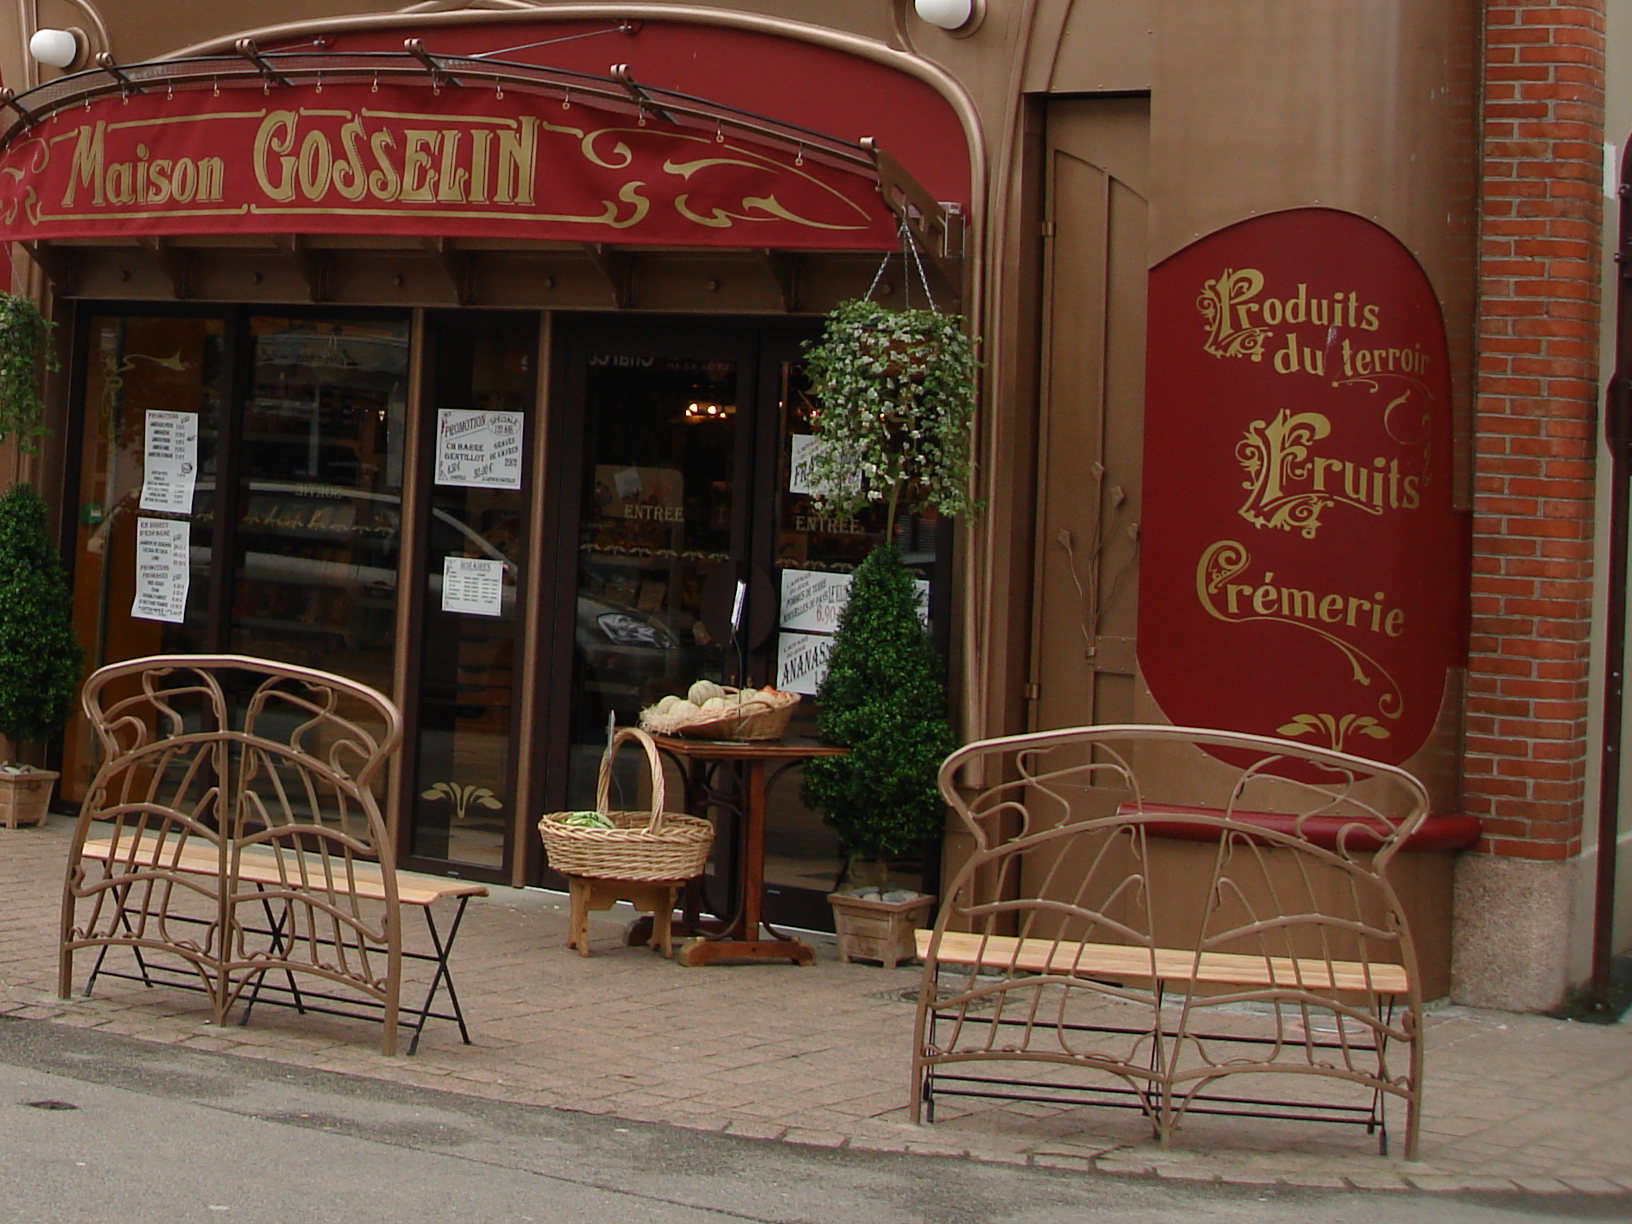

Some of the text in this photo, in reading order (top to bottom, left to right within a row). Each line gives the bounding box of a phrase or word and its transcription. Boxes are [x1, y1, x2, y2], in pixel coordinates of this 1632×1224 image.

[61, 110, 538, 207] Maison GOSSELIN
[1198, 267, 1380, 354] Produits
[1273, 333, 1430, 377] du terroir
[445, 413, 486, 437] PROMOTION
[1237, 408, 1421, 528] Fruits
[1195, 539, 1405, 638] Crémerie
[781, 642, 826, 687] ANANAS
